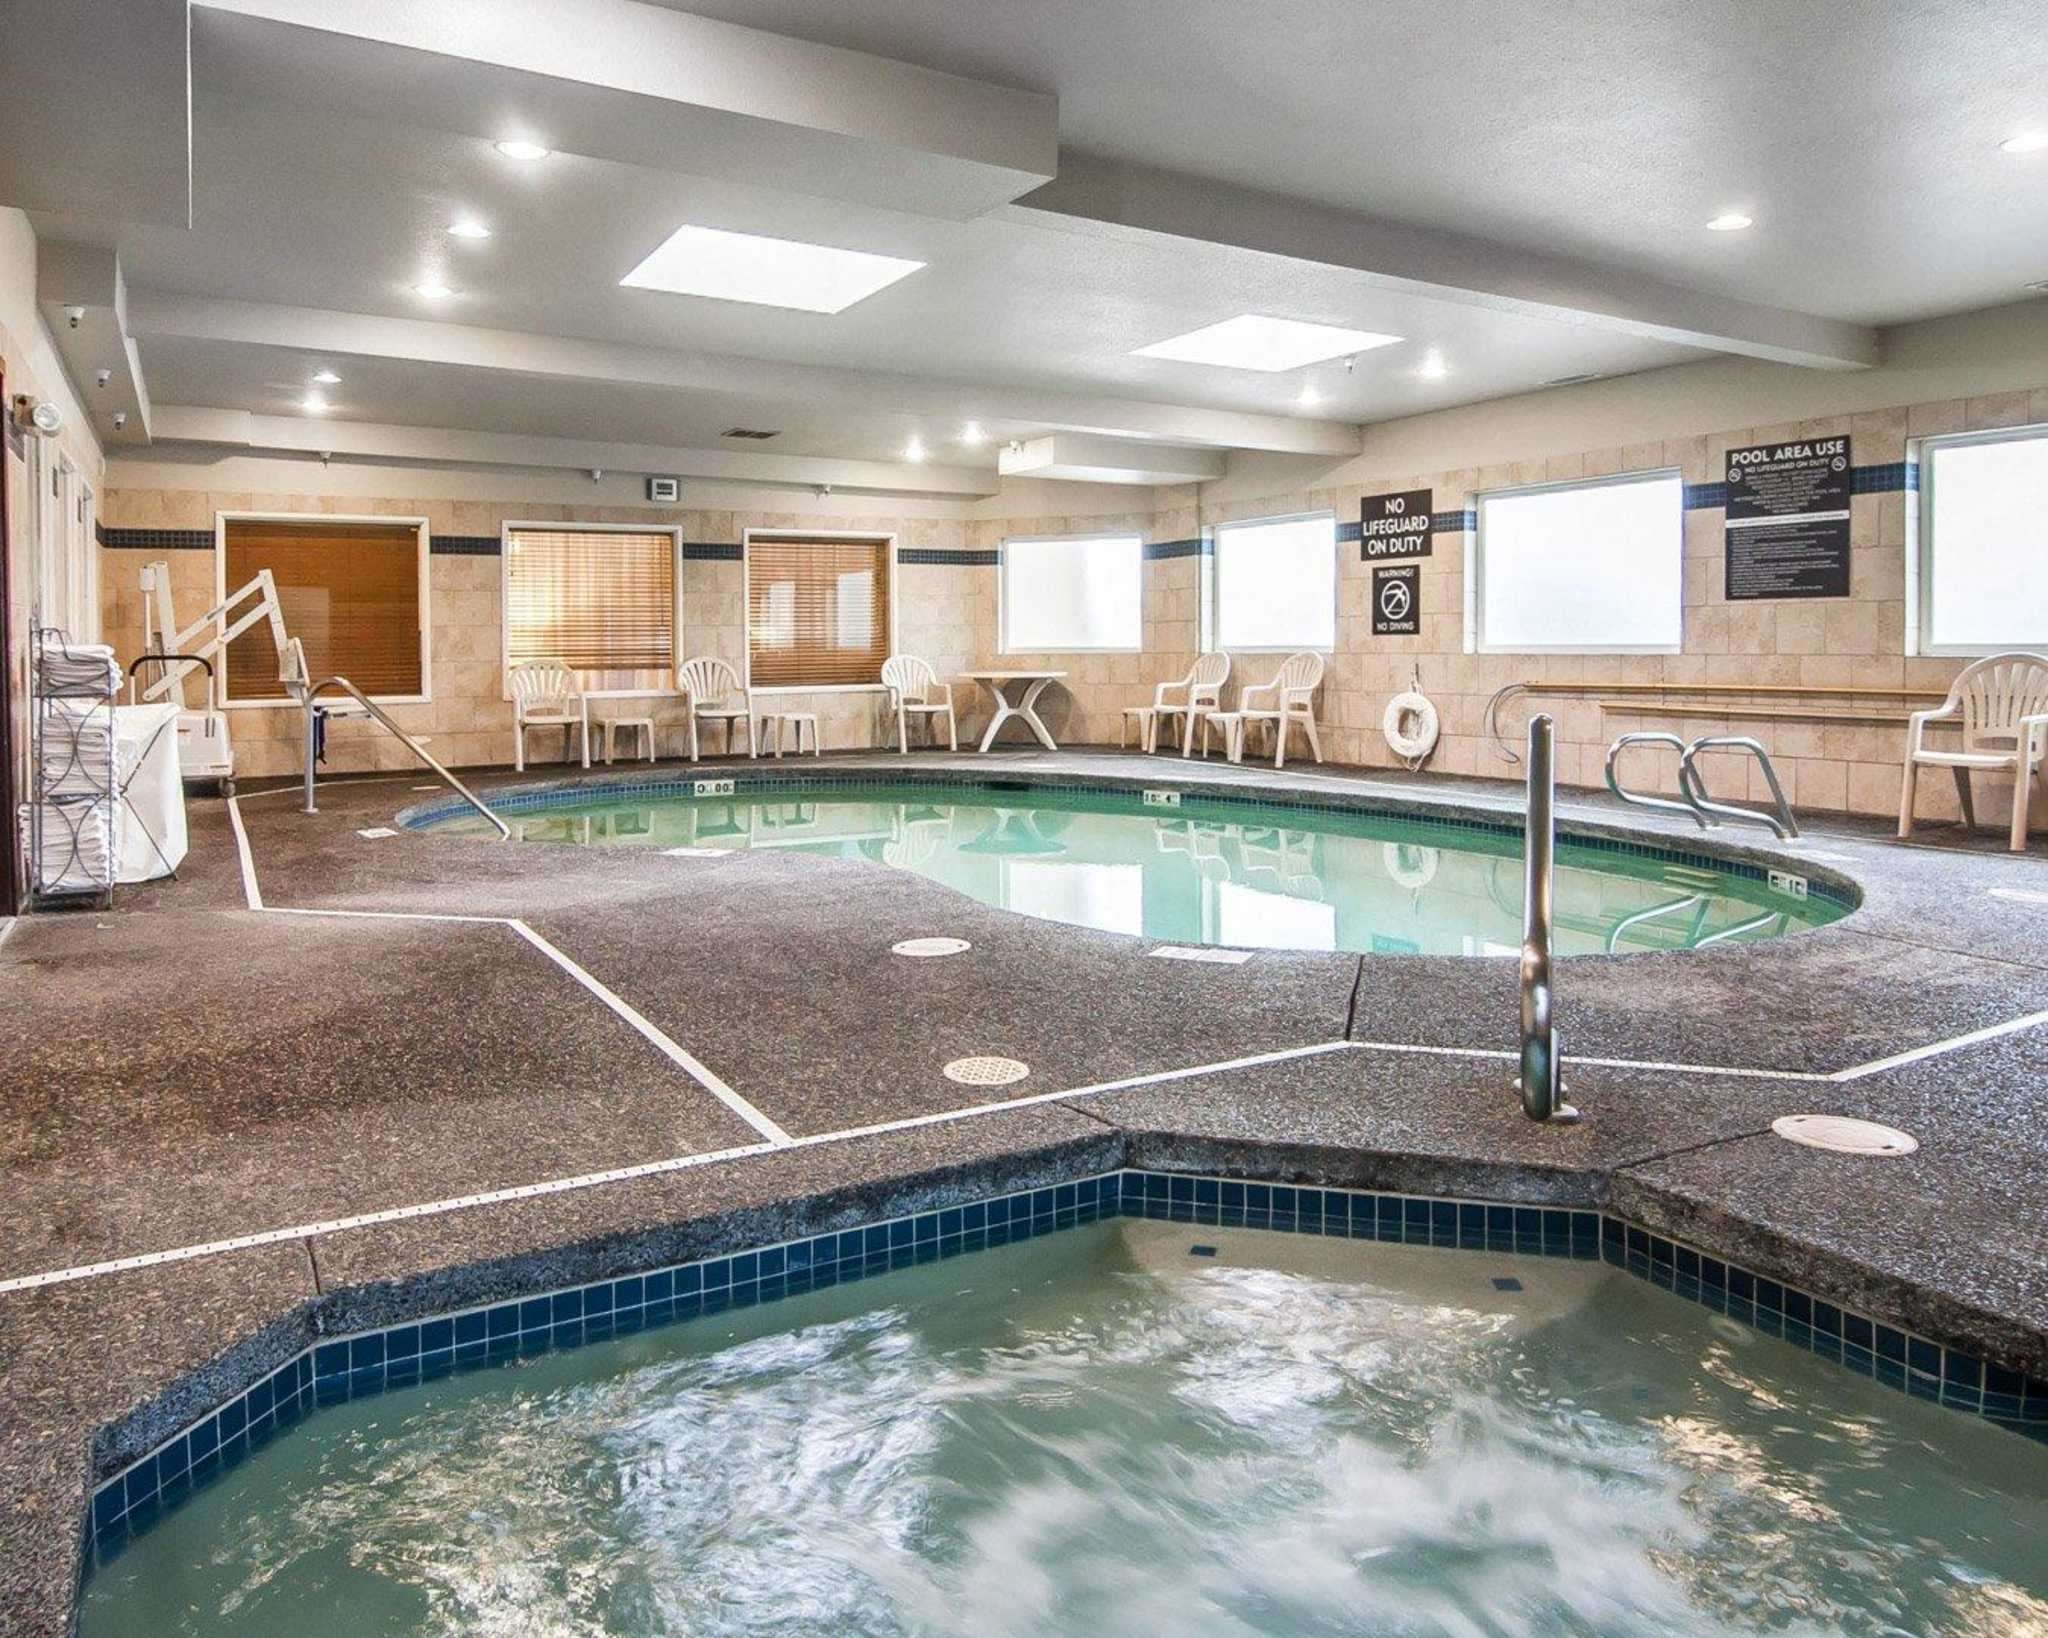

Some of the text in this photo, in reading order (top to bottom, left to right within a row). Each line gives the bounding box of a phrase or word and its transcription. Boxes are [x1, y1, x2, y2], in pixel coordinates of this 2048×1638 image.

[1731, 440, 1845, 465] POOL AREA USE
[1744, 457, 1830, 473] NO LIFEGUARD ON DUTY
[1385, 497, 1405, 514] NO
[1363, 515, 1429, 536] LIFEGUARD
[1367, 535, 1424, 555] ON DUTY
[1376, 621, 1415, 631] NO DIVING
